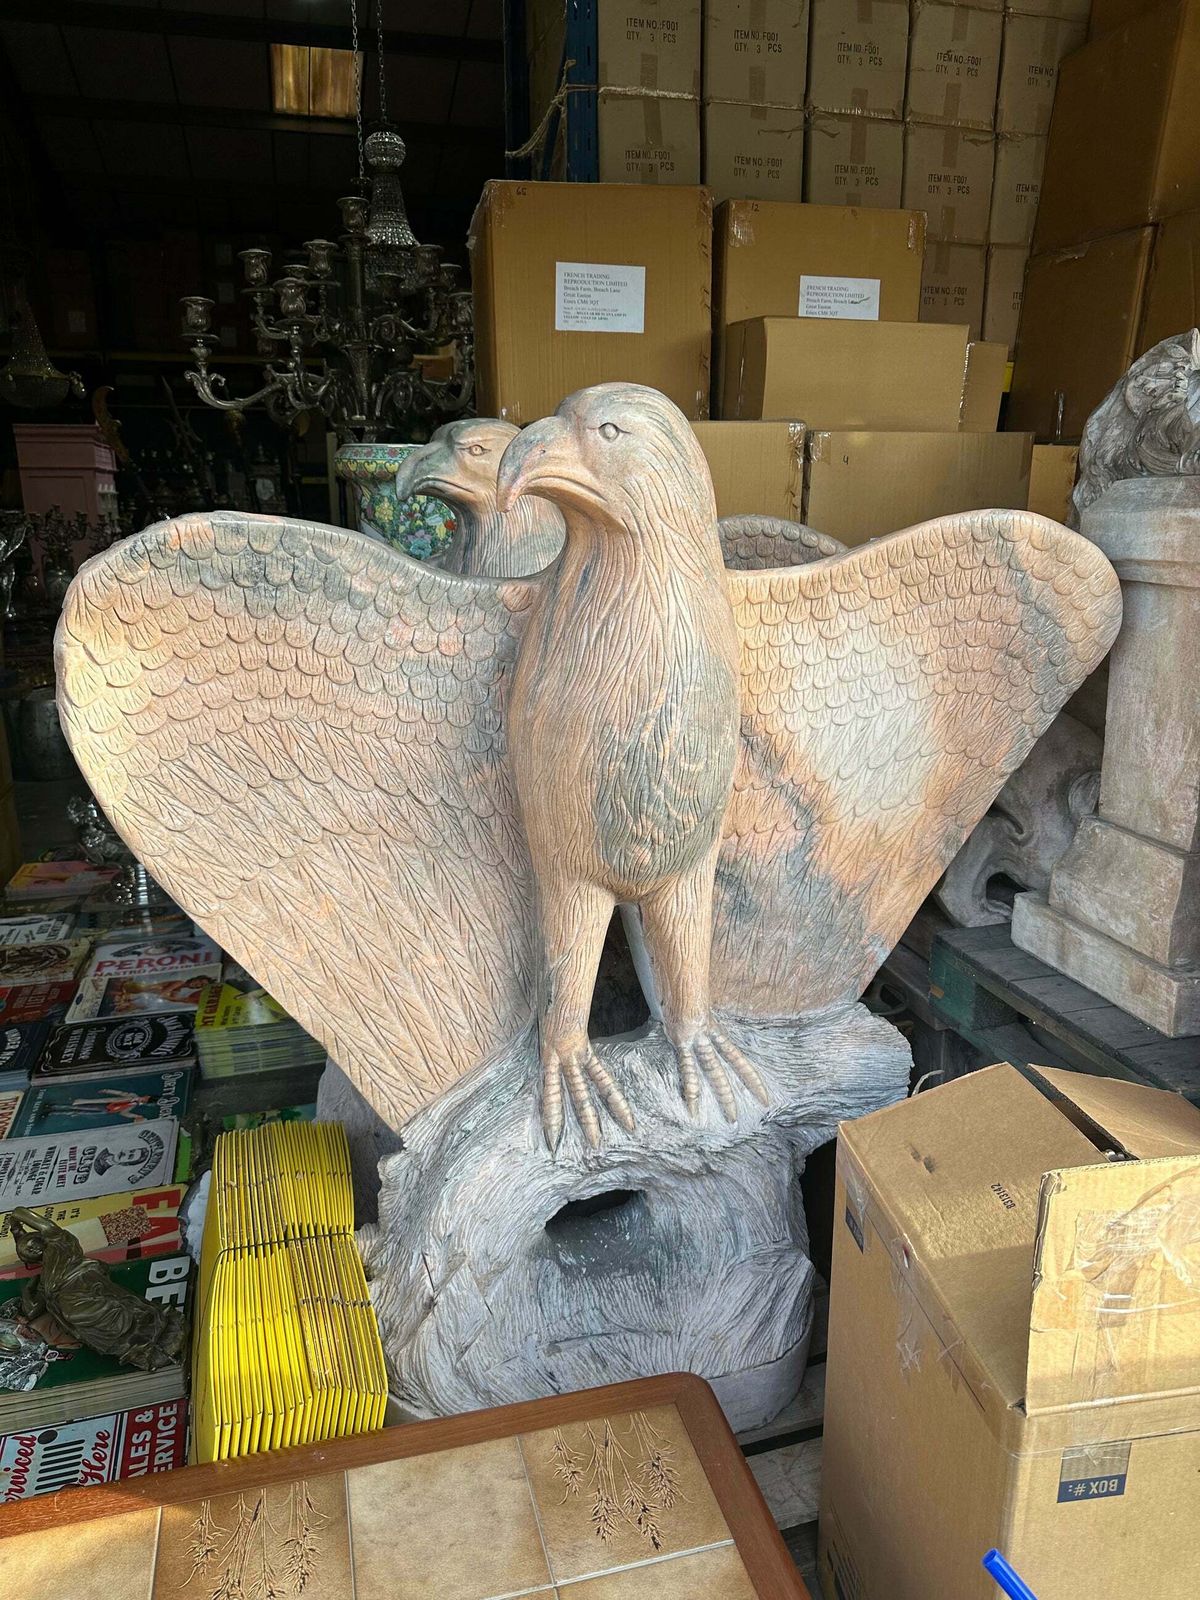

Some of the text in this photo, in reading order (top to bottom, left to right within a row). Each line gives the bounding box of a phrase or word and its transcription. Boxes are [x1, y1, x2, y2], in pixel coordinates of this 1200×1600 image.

[626, 18, 645, 28] ITEM
[650, 34, 655, 42] 3
[663, 33, 677, 43] PCS
[733, 30, 750, 40] ITEM
[756, 44, 761, 54] 3
[767, 43, 783, 53] PCS
[837, 42, 852, 52] ITEM
[858, 57, 863, 66] 3
[868, 56, 883, 67] PCS
[936, 52, 953, 63] ITEM
[956, 67, 960, 75] 3
[966, 67, 978, 78] PCS
[1028, 65, 1042, 76] ITEM
[625, 150, 641, 160] ITEM
[734, 155, 751, 165] ITEM
[648, 164, 653, 173] 3
[660, 162, 675, 172] PCS
[834, 165, 849, 174] ITEM
[755, 169, 760, 178] 3
[767, 169, 780, 180] PCS
[928, 173, 942, 183] ITEM
[855, 178, 860, 187] 3
[865, 176, 879, 186] PCS
[947, 187, 952, 195] 3
[957, 186, 970, 195] PCS
[1015, 183, 1029, 193] ITEM
[563, 279, 605, 287] REPRODUCTION
[1012, 291, 1023, 300] ITE
[95, 952, 213, 972] PERONI
[60, 1028, 83, 1064] WHISKEY
[161, 1071, 184, 1096] DIRTY
[73, 1145, 98, 1185] CLUB
[44, 1207, 55, 1219] COO
[56, 1209, 67, 1221] THE
[71, 1207, 81, 1219] IT'S
[135, 1409, 154, 1423] &
[78, 1429, 111, 1484] Here
[1089, 1478, 1118, 1495] BOX
